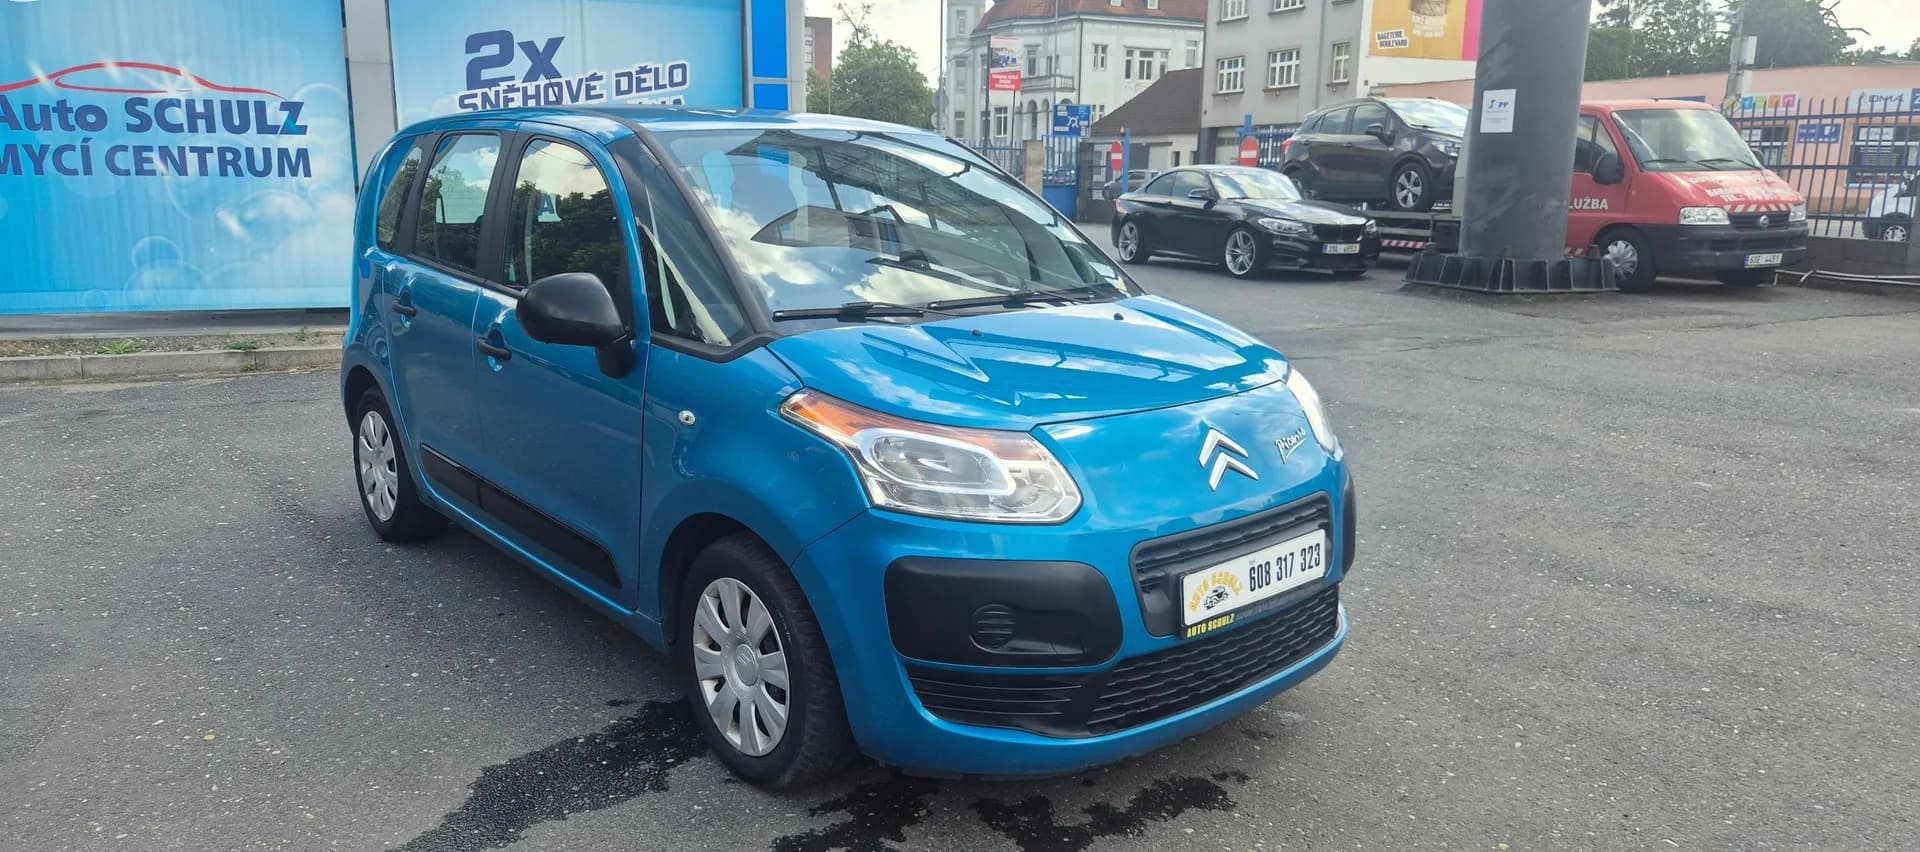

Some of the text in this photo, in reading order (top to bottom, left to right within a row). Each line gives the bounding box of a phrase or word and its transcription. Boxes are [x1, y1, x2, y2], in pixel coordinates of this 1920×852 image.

[465, 29, 565, 91] 2x
[615, 62, 688, 97] DĚLO
[0, 95, 308, 135] Auto SCHULZ
[0, 137, 312, 178] MYCÍ CENTRUM
[1249, 542, 1321, 592] 608 317 323
[1187, 623, 1207, 639] AUTO
